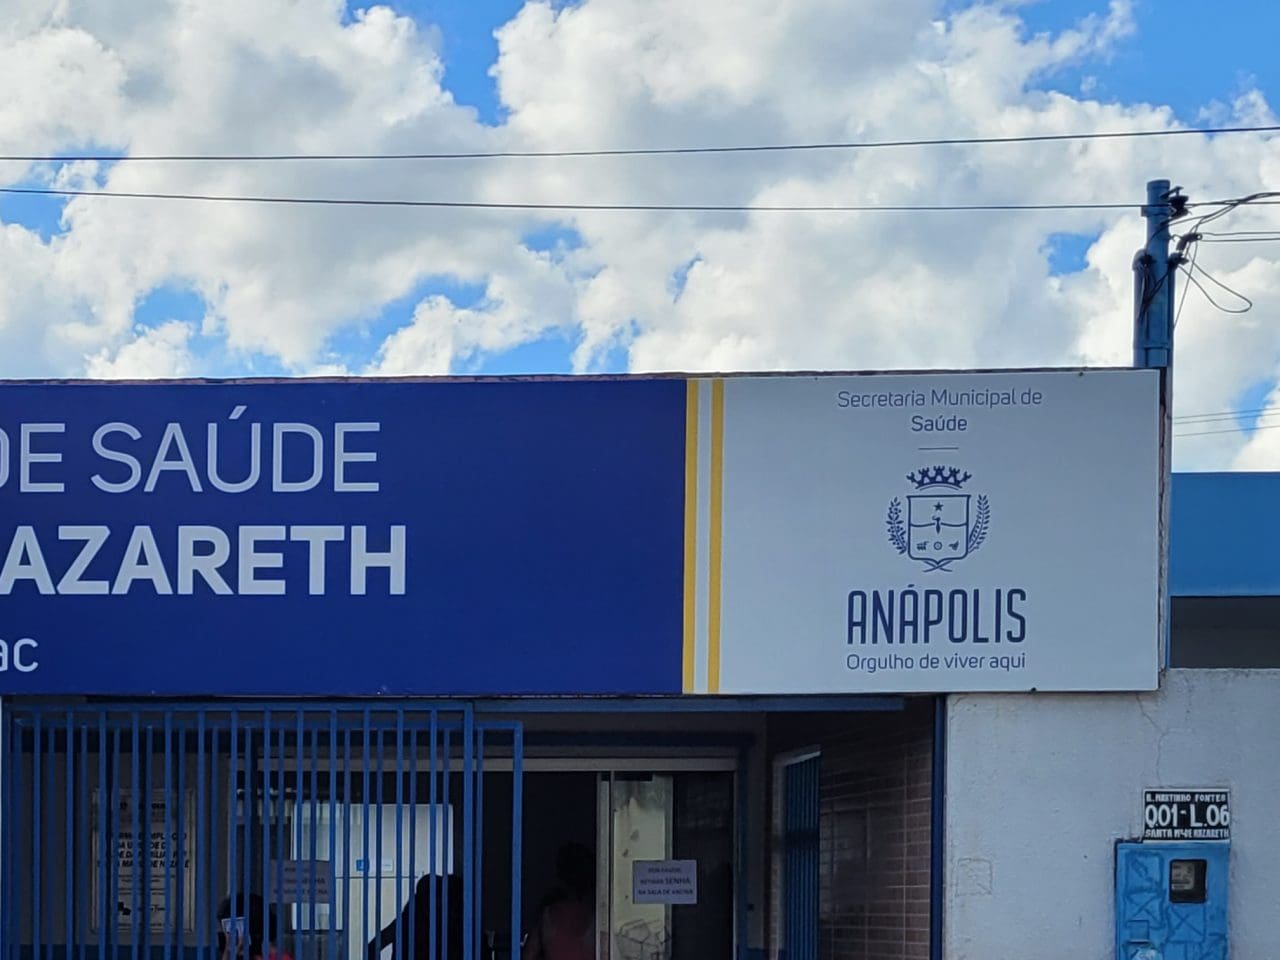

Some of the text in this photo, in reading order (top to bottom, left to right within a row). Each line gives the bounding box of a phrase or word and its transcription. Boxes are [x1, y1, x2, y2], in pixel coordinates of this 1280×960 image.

[837, 388, 1042, 409] Secretaria Municipal de
[910, 415, 968, 432] Saúde
[90, 405, 380, 494] SAÚDE
[847, 584, 1027, 644] ANÁPOLIS
[847, 652, 1026, 673] Orgulho de viver aqui
